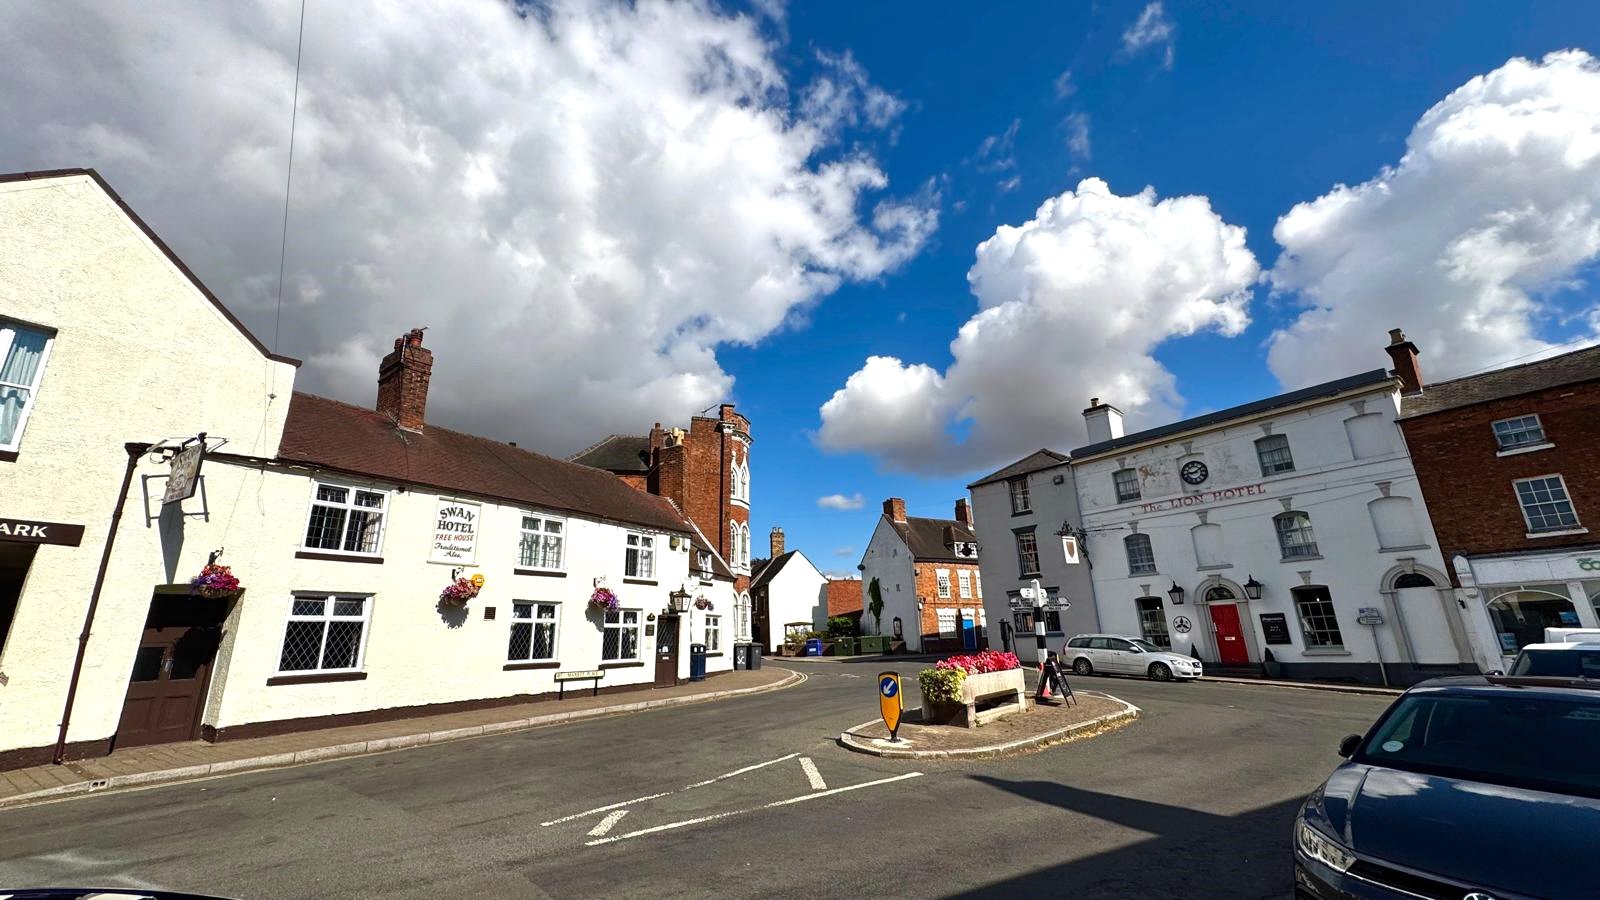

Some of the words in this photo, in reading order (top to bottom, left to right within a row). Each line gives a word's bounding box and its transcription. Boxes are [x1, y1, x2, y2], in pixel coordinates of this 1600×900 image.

[1142, 503, 1161, 513] The
[1169, 495, 1205, 508] LION
[1213, 483, 1266, 500] HOTEL
[440, 507, 475, 522] SWAN
[437, 520, 474, 534] HOTEL
[435, 533, 452, 541] FREE
[453, 534, 474, 542] HOUSE
[434, 543, 472, 552] Traditional
